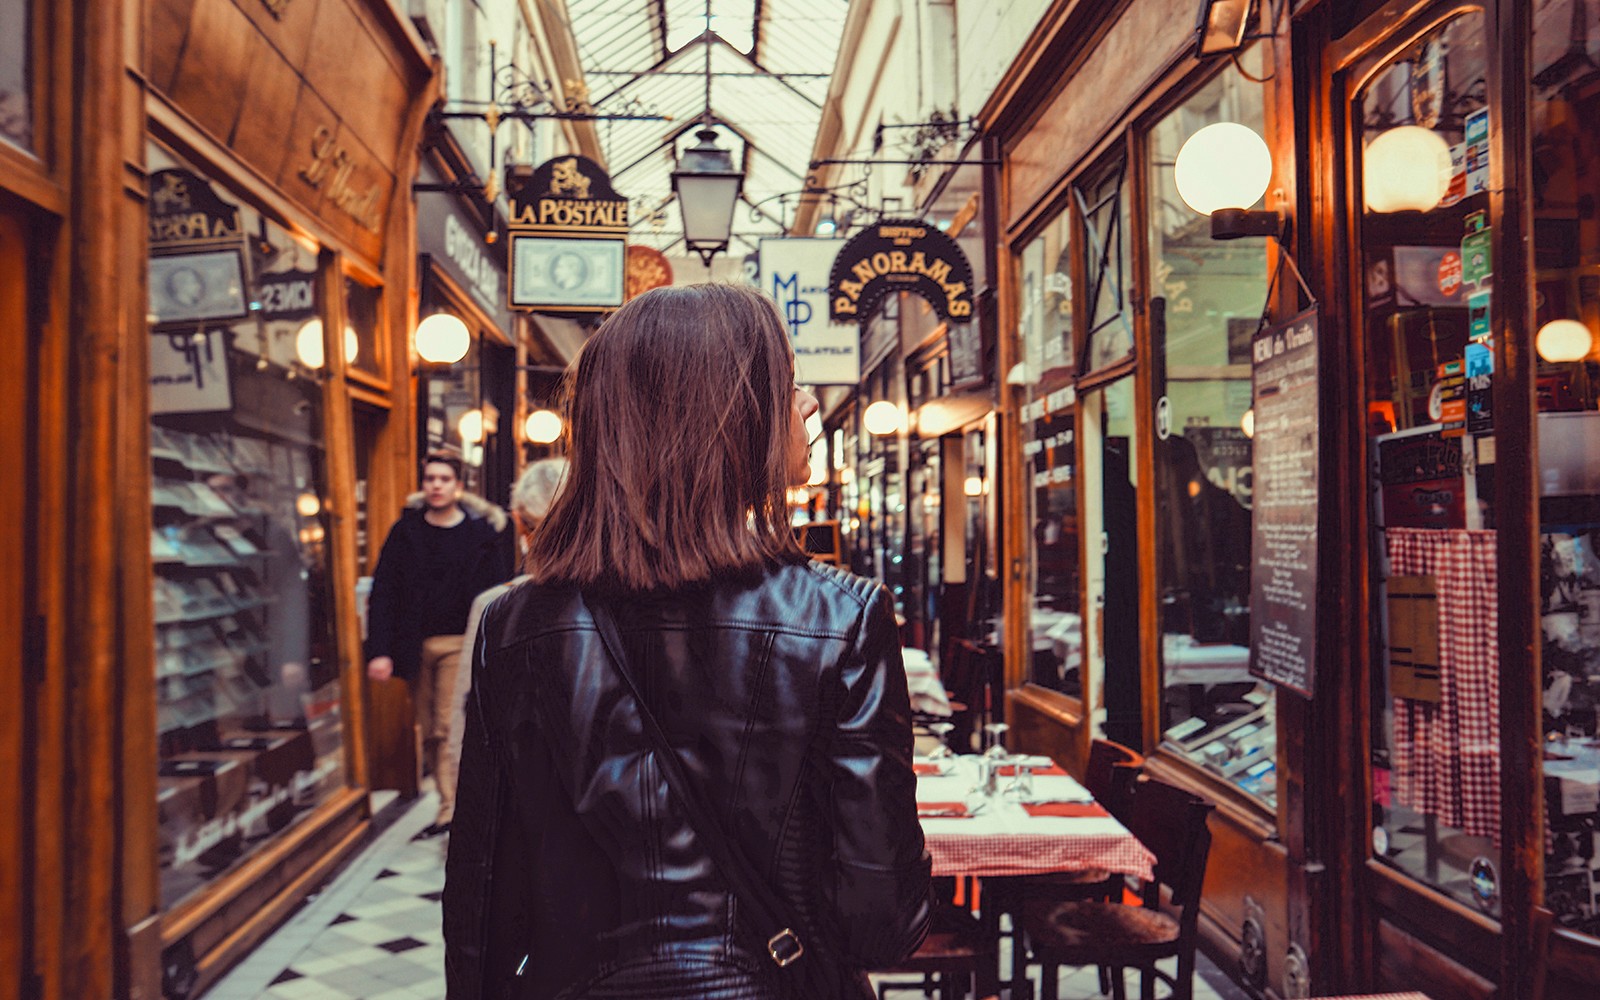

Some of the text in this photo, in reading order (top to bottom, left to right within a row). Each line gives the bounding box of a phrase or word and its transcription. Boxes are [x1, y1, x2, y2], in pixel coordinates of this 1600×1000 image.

[509, 199, 627, 226] LA POSTALE
[834, 250, 972, 317] PANORAMAS
